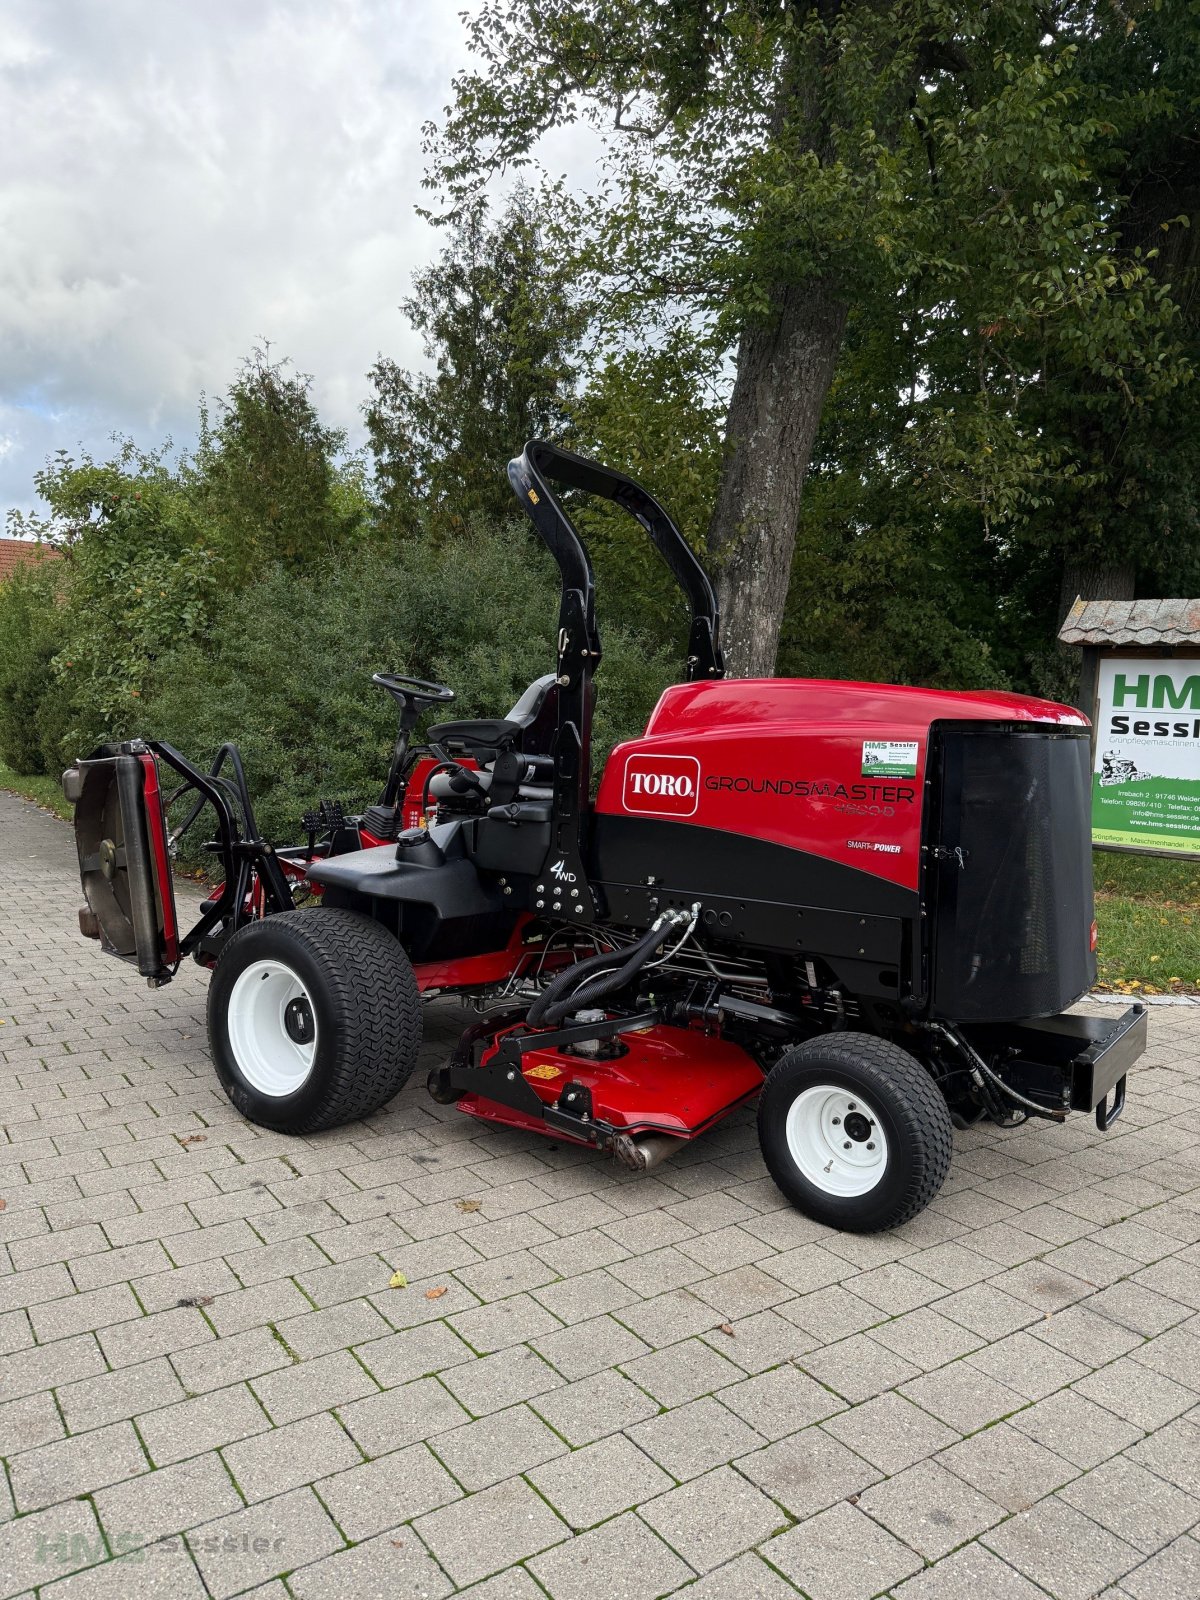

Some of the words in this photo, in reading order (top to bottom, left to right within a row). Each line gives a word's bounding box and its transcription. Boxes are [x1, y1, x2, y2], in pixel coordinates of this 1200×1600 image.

[864, 742, 887, 750] HMS
[705, 775, 914, 803] GROUNDSMASTER
[873, 843, 901, 854] POWER
